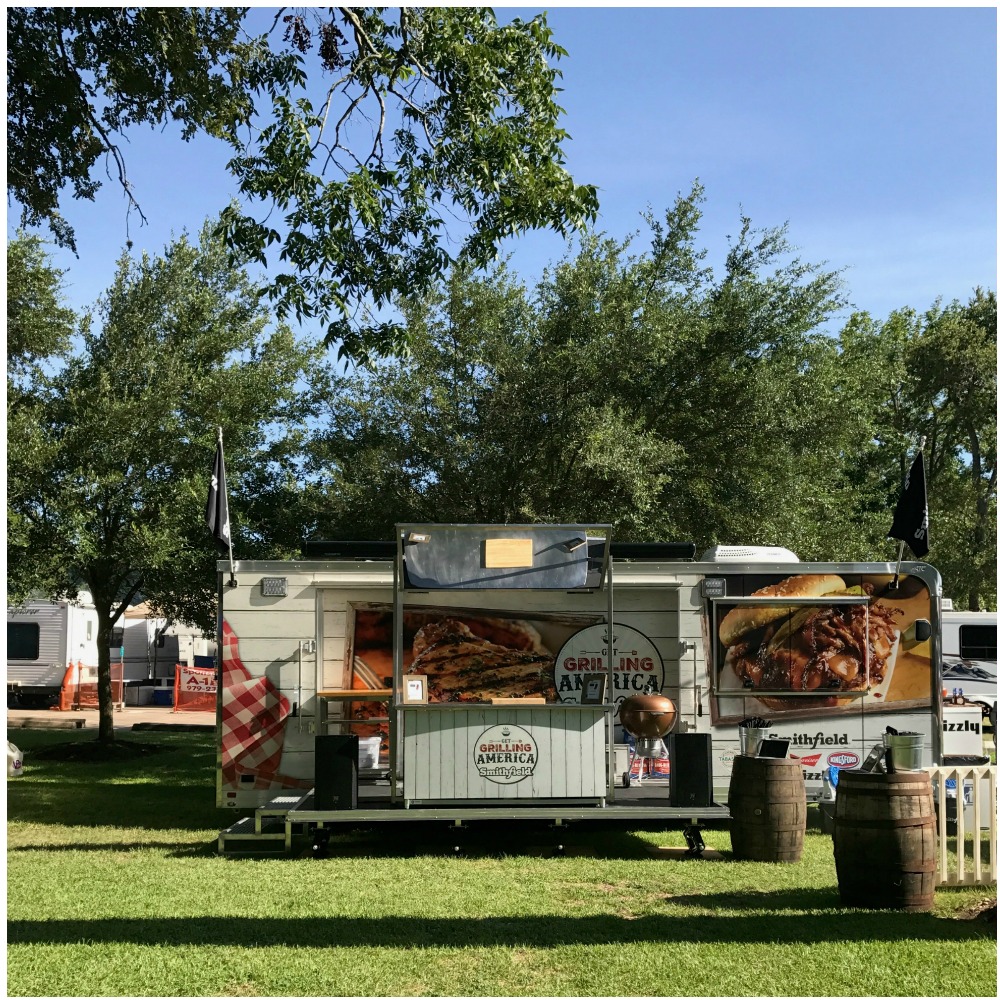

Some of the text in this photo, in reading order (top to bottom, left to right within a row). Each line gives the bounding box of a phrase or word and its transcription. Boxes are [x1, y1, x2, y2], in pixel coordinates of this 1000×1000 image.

[602, 648, 618, 656] GT
[480, 744, 532, 752] GRILLING
[477, 753, 534, 764] AMERICA
[830, 756, 857, 765] KINGSFORD
[479, 766, 533, 779] Smithfield
